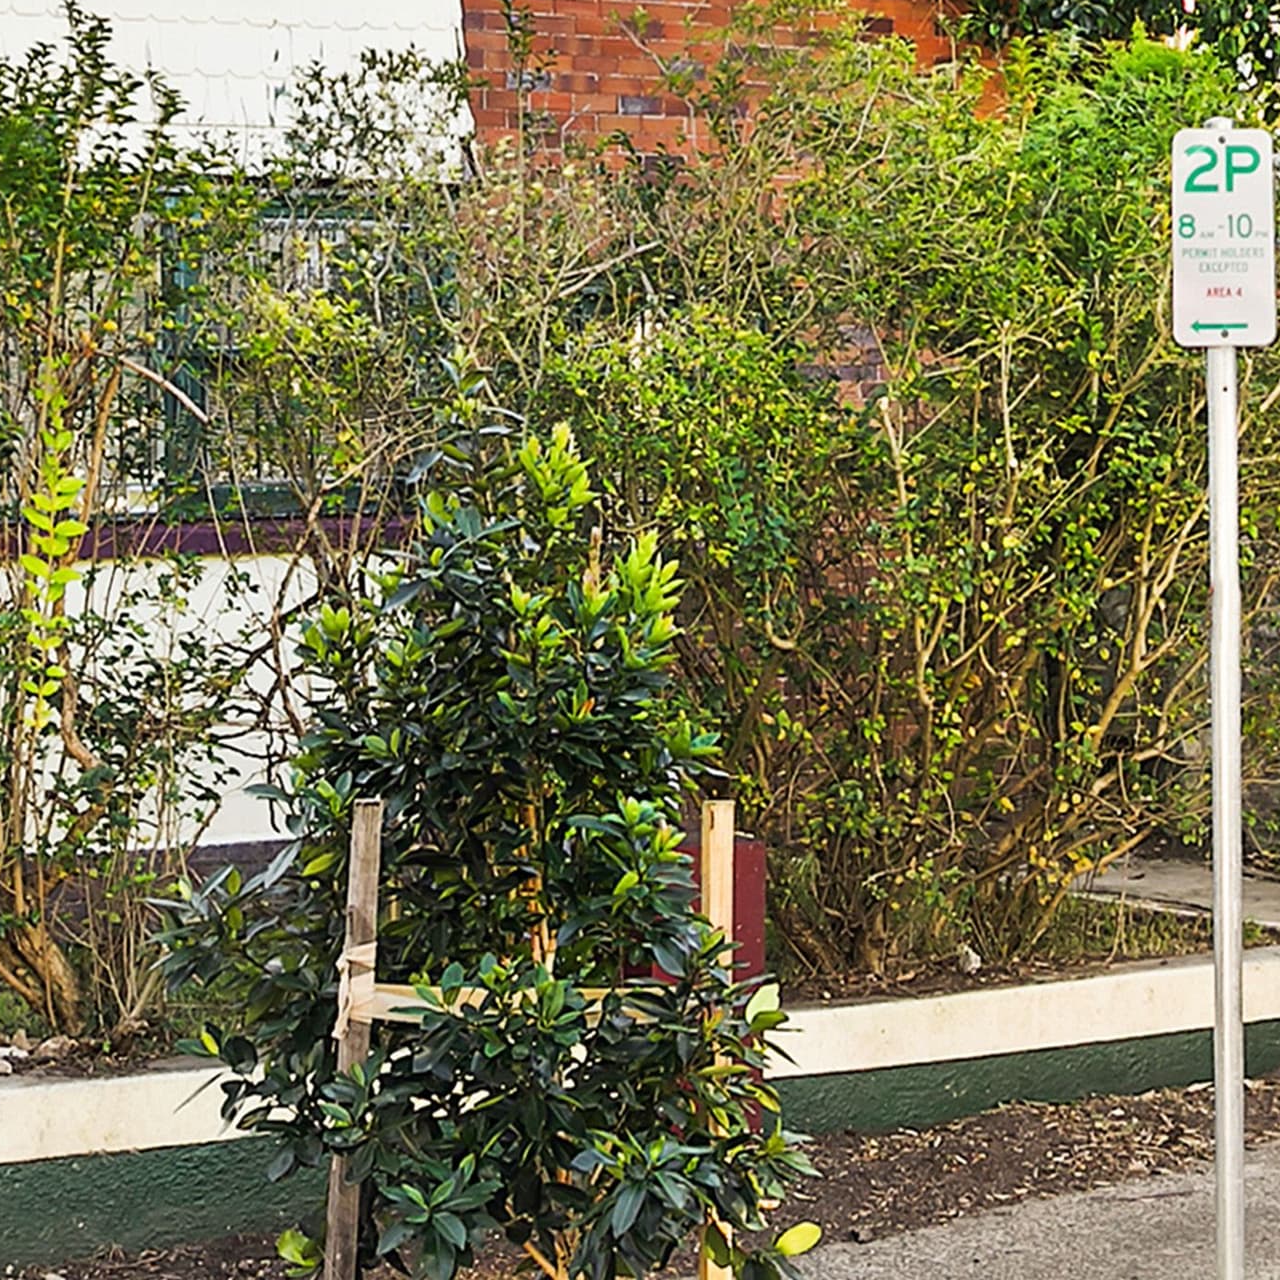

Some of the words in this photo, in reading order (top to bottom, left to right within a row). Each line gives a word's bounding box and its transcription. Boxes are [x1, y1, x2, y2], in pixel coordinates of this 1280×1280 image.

[1183, 144, 1261, 193] 2P
[1178, 213, 1196, 239] 8
[1182, 247, 1218, 257] PERMIT
[1220, 247, 1265, 258] HOLDERS
[1198, 262, 1249, 273] EXCEPTED
[1206, 287, 1232, 297] AREA
[1235, 287, 1243, 297] 4
